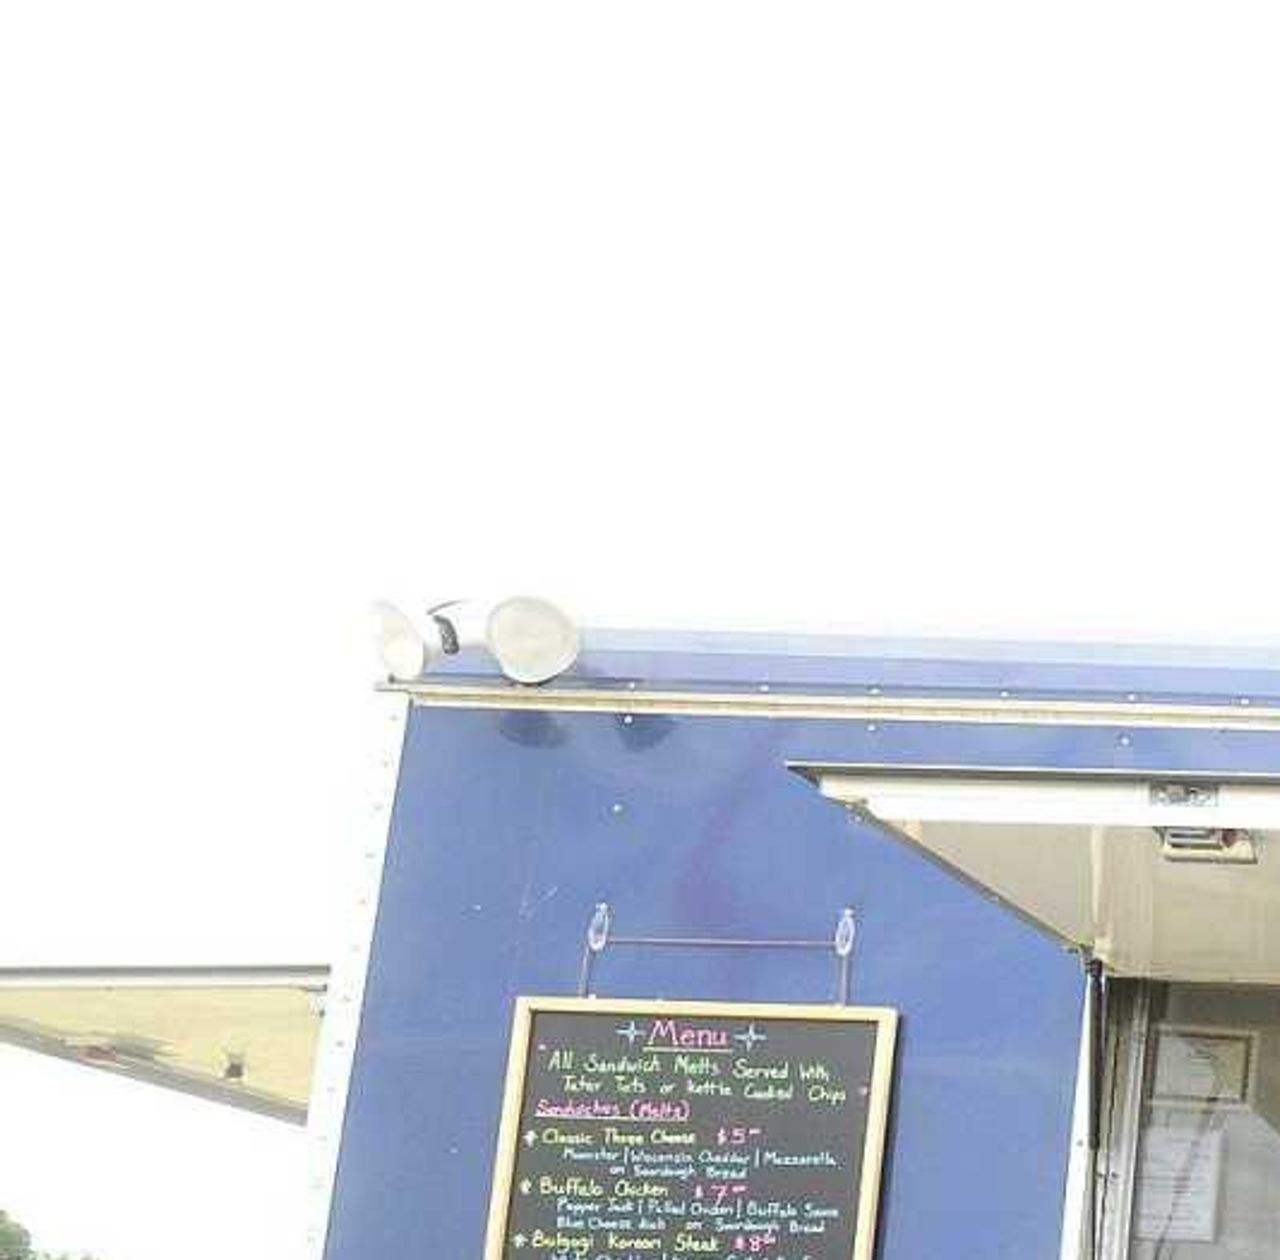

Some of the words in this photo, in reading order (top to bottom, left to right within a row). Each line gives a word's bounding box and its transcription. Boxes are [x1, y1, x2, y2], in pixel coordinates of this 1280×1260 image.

[648, 1019, 728, 1047] Menu
[548, 1050, 573, 1070] All
[584, 1053, 662, 1073] Sandwich
[674, 1055, 720, 1076] Melts
[732, 1059, 789, 1080] Served
[660, 1082, 675, 1094] or
[808, 1085, 846, 1105] Chips
[605, 1128, 644, 1145] Three
[650, 1129, 697, 1145] Cheese
[540, 1176, 604, 1196] Buffalo
[614, 1180, 669, 1197] Chicken
[747, 1202, 798, 1218] Buffalo
[532, 1229, 594, 1255] Bulgogi
[609, 1232, 662, 1250] Korean
[674, 1233, 720, 1252] Steak
